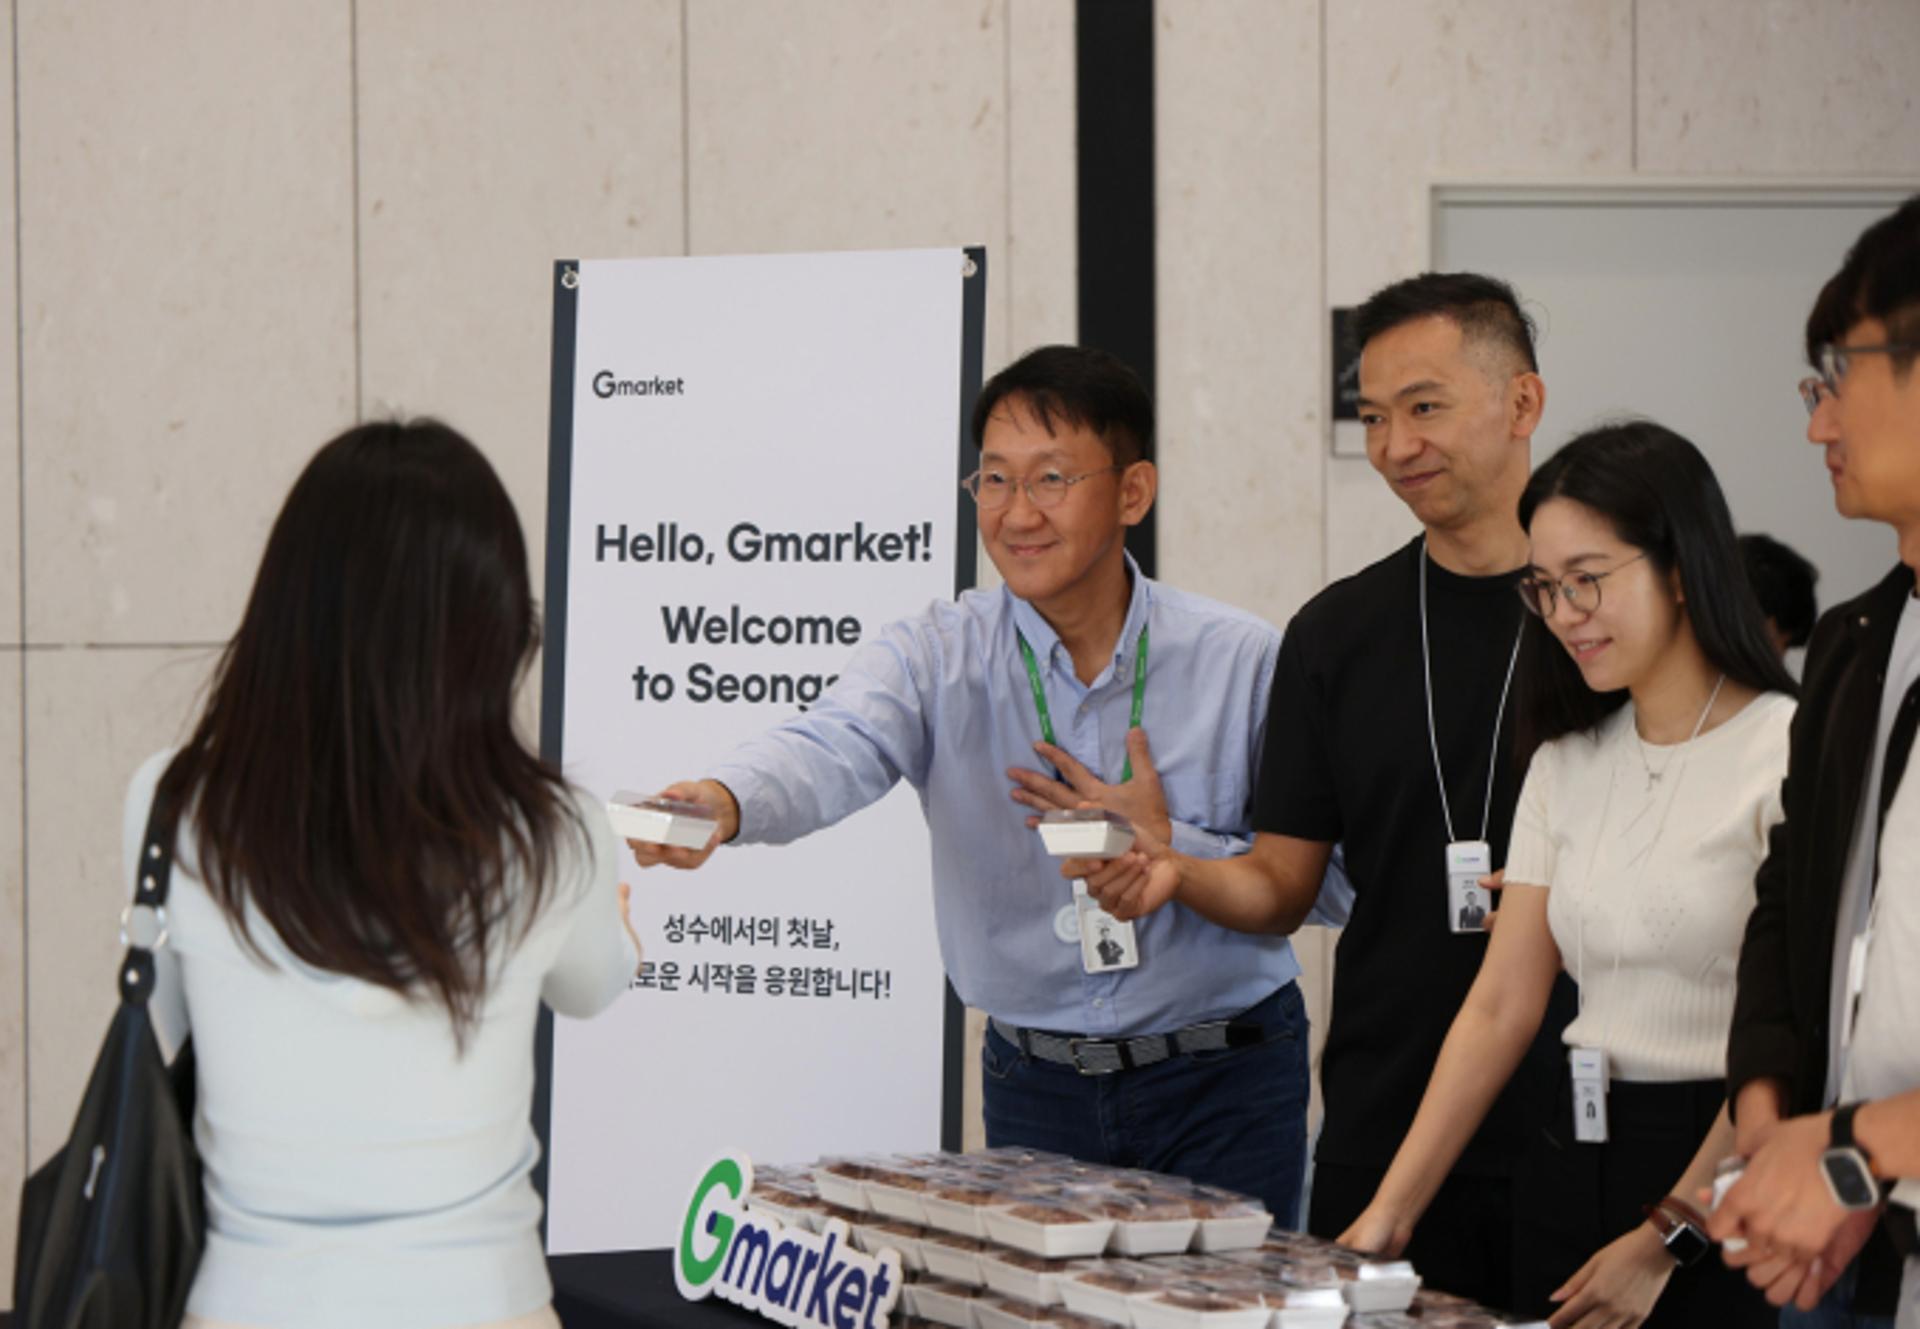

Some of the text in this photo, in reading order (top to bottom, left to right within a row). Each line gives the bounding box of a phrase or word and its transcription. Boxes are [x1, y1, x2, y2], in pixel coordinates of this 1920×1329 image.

[592, 370, 684, 398] Gmarket
[595, 521, 932, 566] Hello, Gmarket!
[660, 604, 862, 646] Welcome
[631, 662, 839, 712] to Seong
[663, 914, 840, 951] 성수에서의 첫날,
[628, 962, 891, 1000] 로운 시작을 응원합니다!
[681, 1158, 890, 1329] Gmarket
